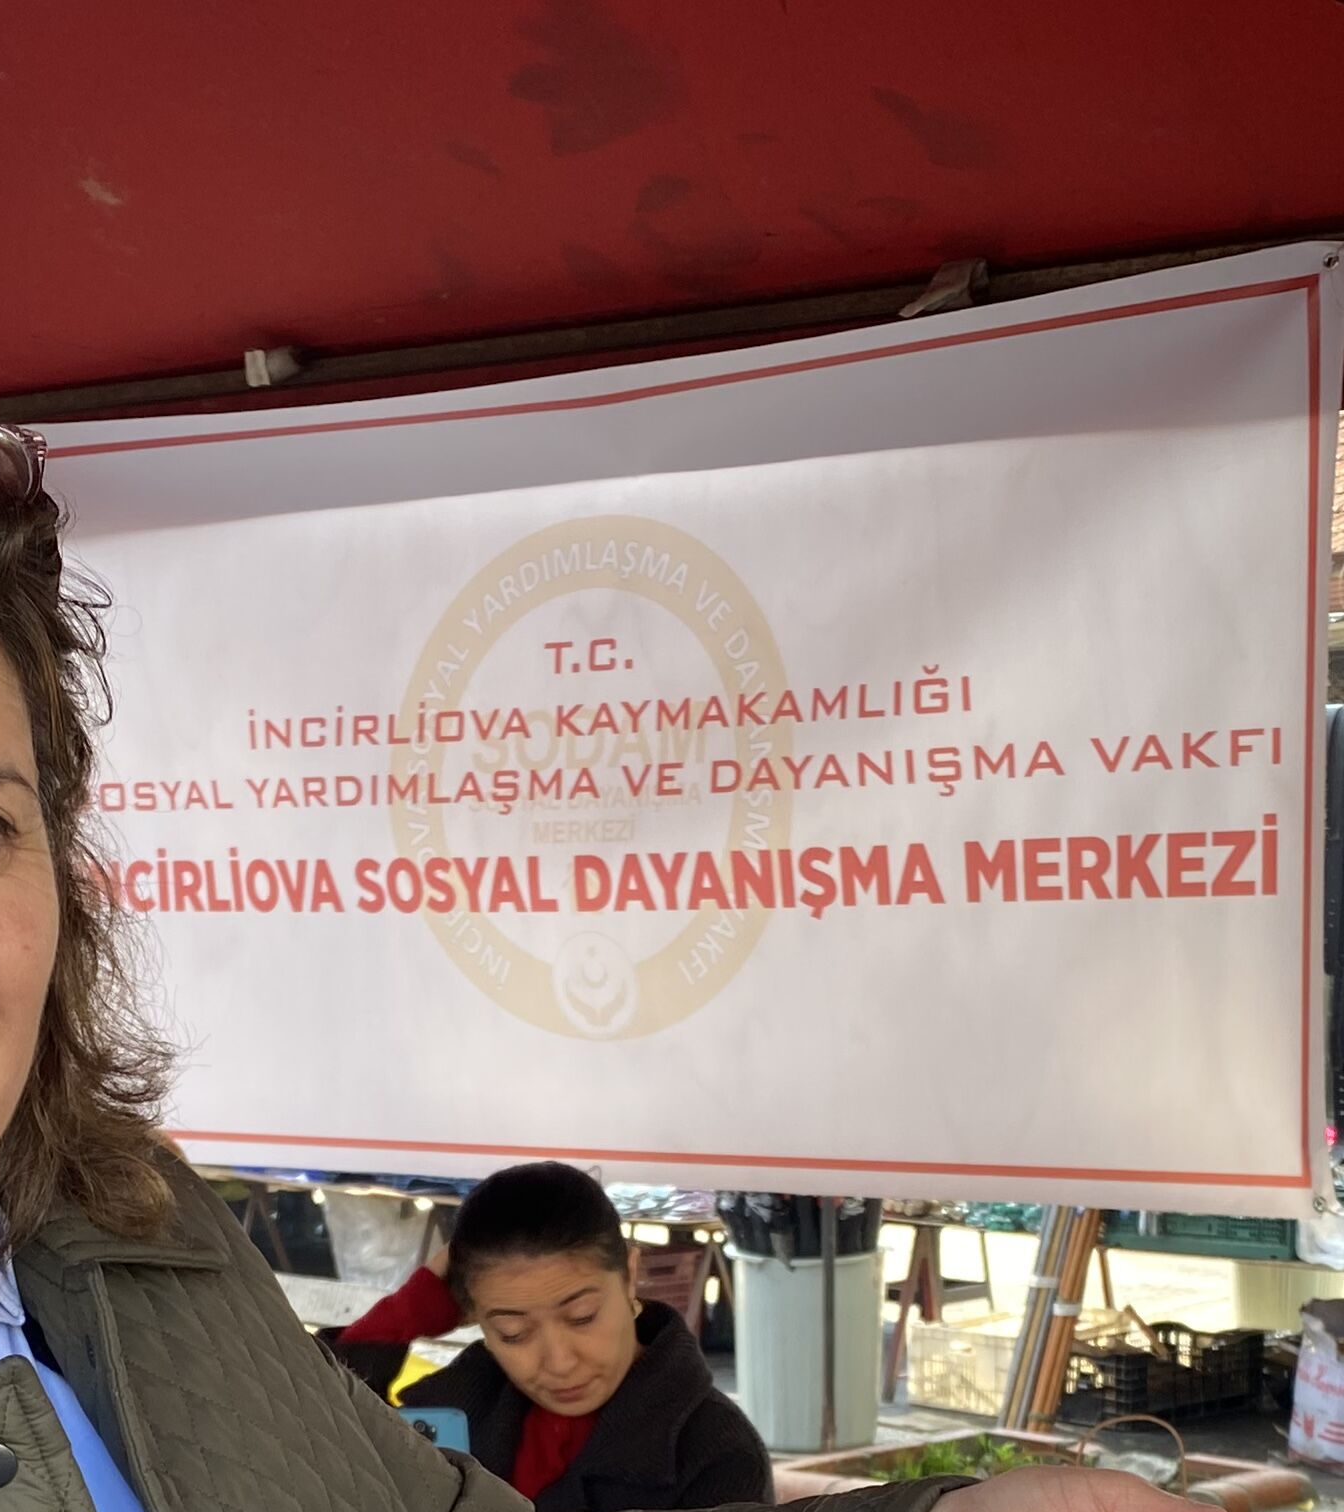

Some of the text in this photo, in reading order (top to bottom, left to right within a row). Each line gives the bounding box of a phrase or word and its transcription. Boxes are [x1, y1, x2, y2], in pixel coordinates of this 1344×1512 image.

[693, 579, 733, 632] VE
[544, 638, 634, 675] T.C.
[247, 664, 973, 751] İNCİRLİOVA KAYMAKAMLIĞI
[76, 727, 1283, 816] OSYAL YARDIMLAŞMA VE DAYANIŞMA VAKFI
[80, 812, 1279, 920] NCİRLİOVA SOSYAL DAYANIŞMA MERKEZİ
